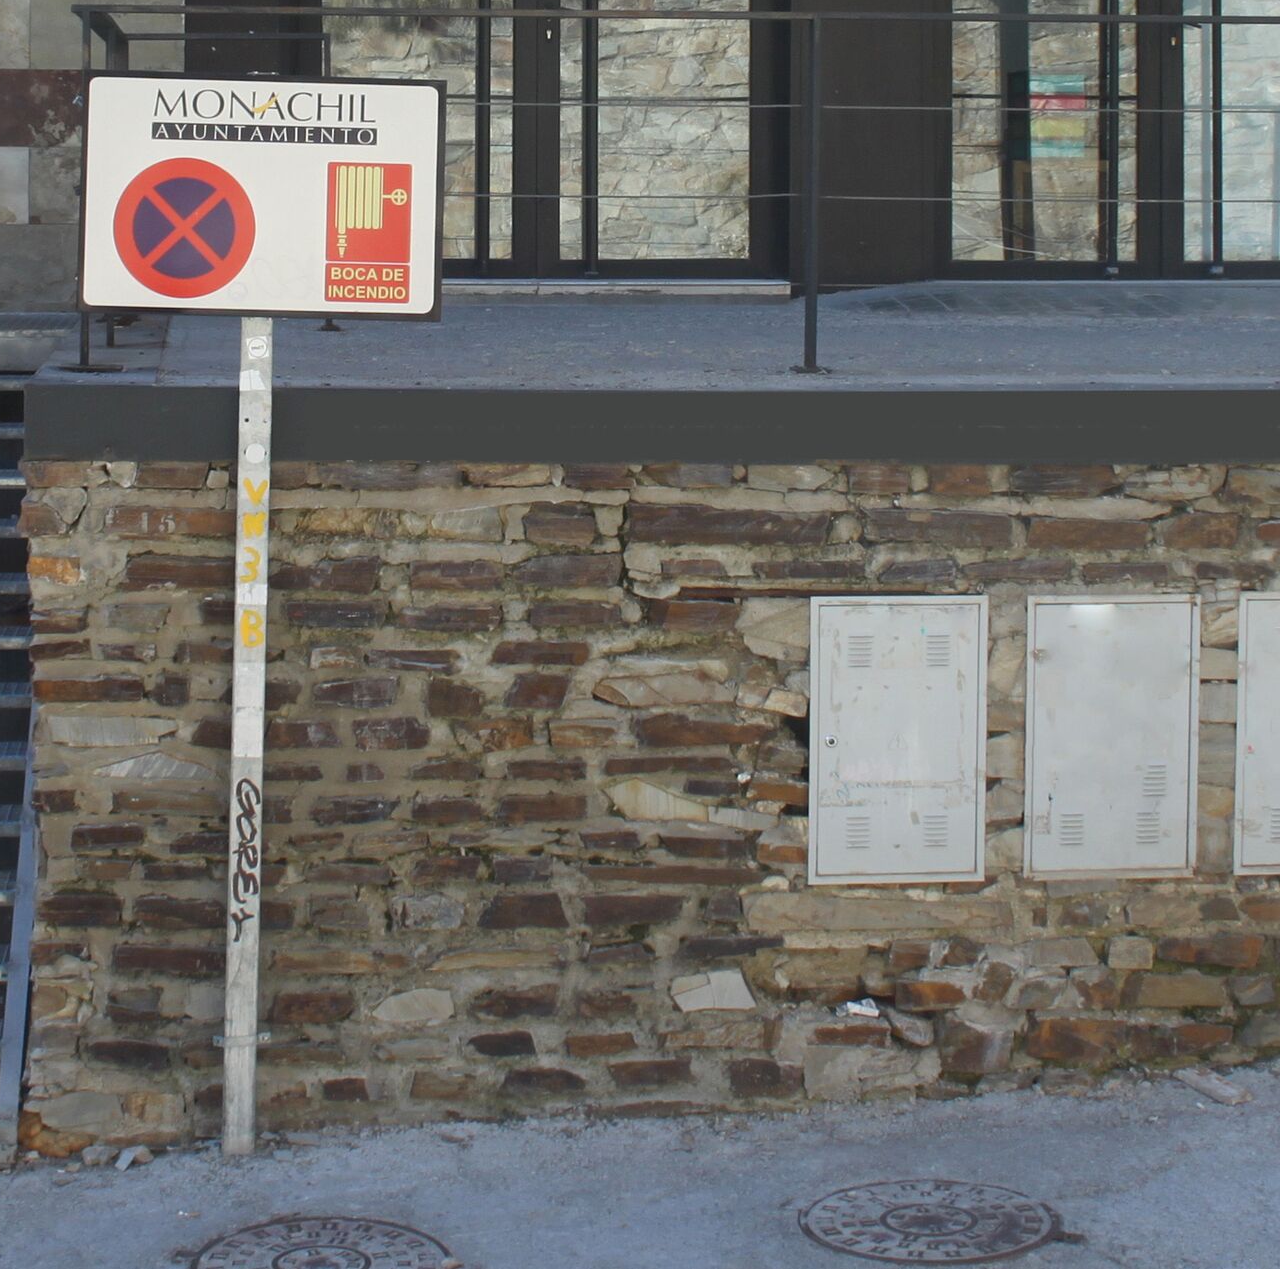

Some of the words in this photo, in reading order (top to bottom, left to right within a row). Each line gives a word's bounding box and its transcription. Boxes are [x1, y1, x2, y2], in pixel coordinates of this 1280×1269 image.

[153, 88, 376, 123] MONACHIL
[155, 123, 375, 145] AYUNTAMIENTO
[330, 267, 379, 282] BOCA
[383, 268, 404, 282] DE
[327, 285, 407, 300] INCENDIO
